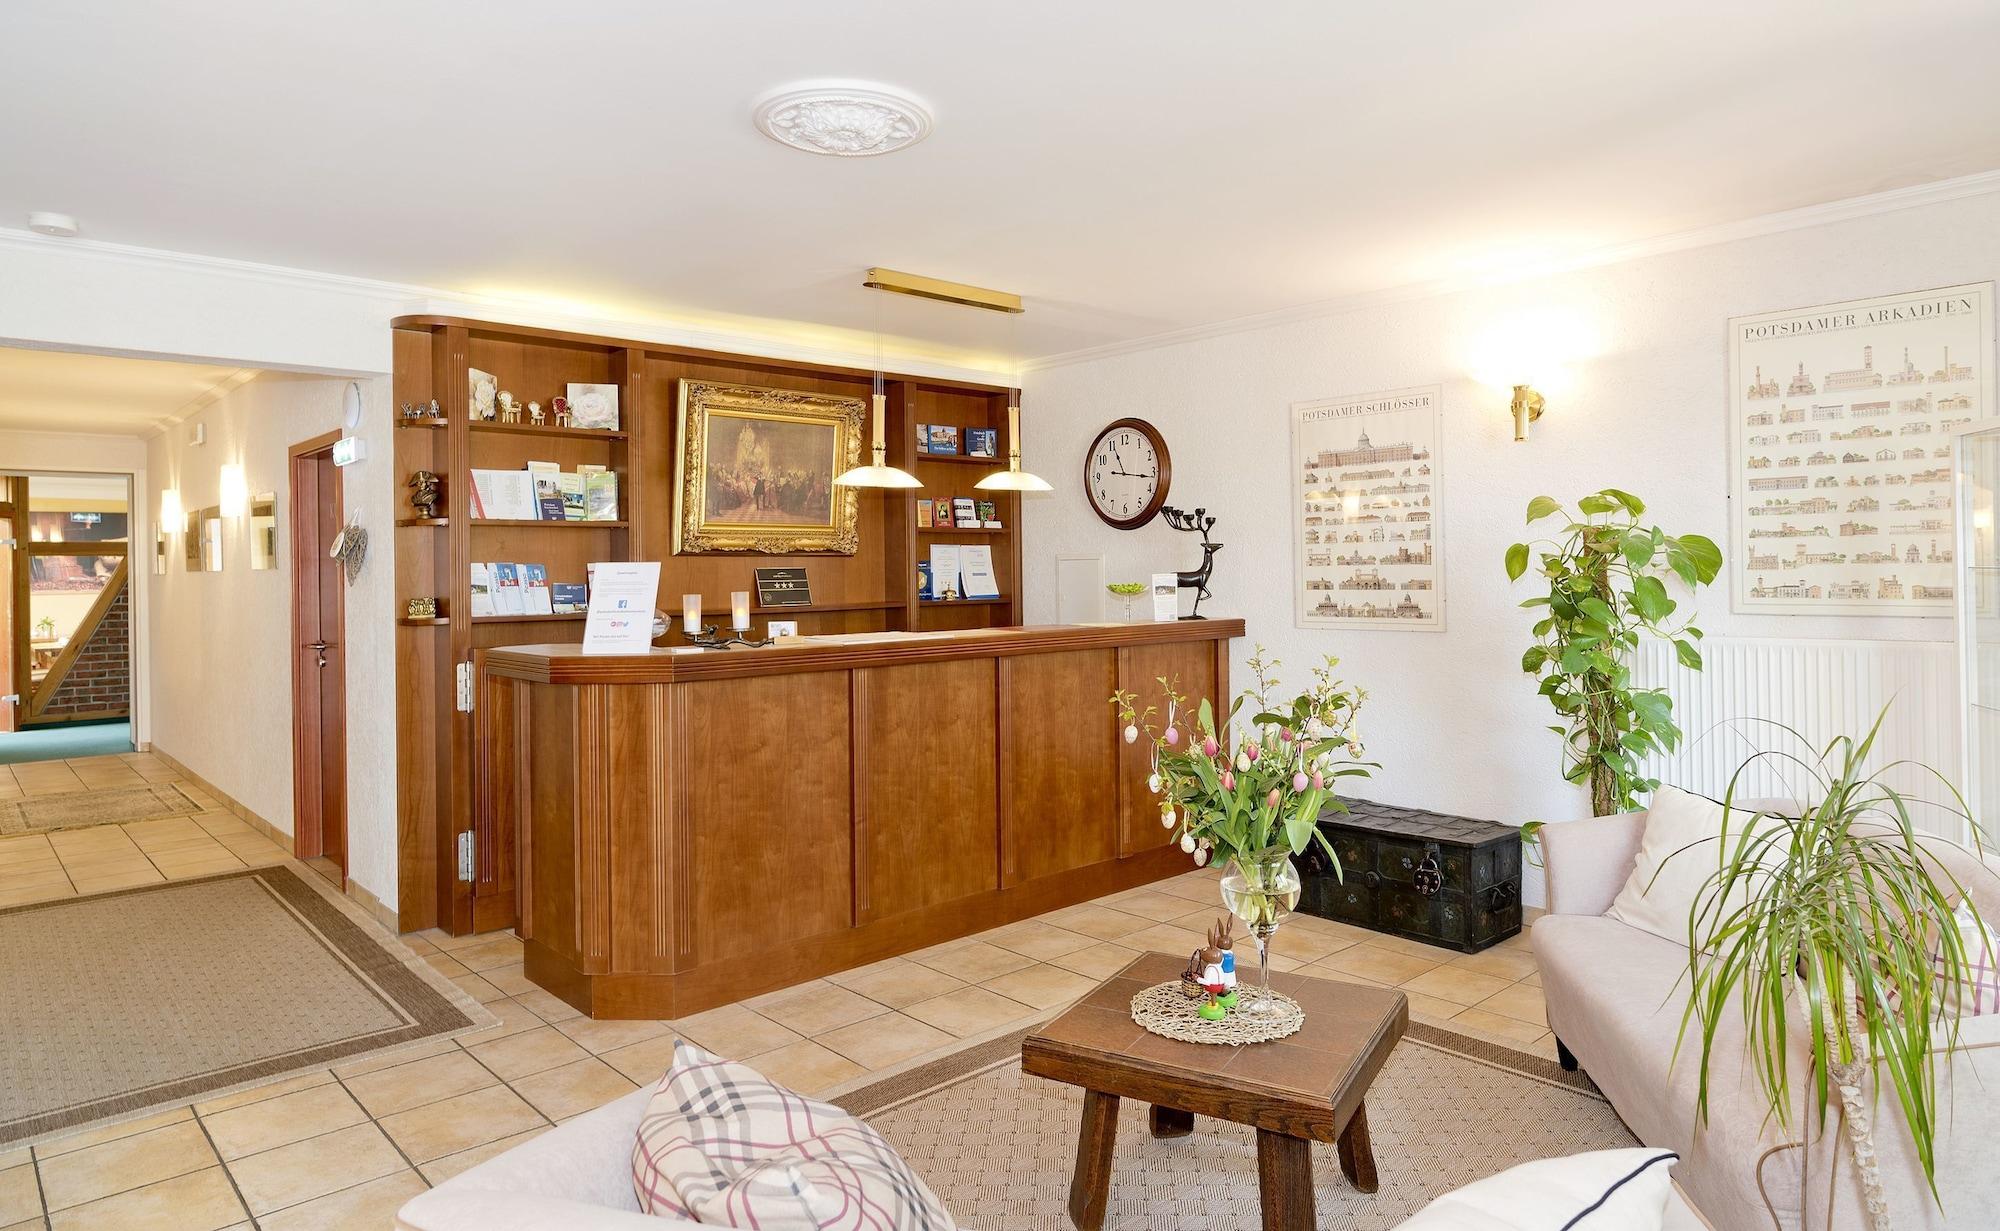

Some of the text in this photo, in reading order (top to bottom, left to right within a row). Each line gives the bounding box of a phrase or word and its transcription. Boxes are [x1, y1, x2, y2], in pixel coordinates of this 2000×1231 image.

[1744, 314, 1856, 339] POTSDAMER
[1864, 298, 1972, 324] ARKADIEN
[1302, 406, 1363, 421] POTSDAMER
[1365, 397, 1430, 413] SCHLÖSSER
[1109, 440, 1116, 452] 11
[1121, 434, 1129, 446] 12
[1099, 454, 1107, 466] 10
[1147, 450, 1152, 461] 2
[1096, 472, 1101, 484] 9
[1151, 466, 1156, 478] 3
[1147, 482, 1152, 494] 4
[1101, 489, 1106, 501] 8
[1110, 499, 1115, 510] 7
[1122, 503, 1128, 514] 6
[1137, 497, 1142, 509] 5
